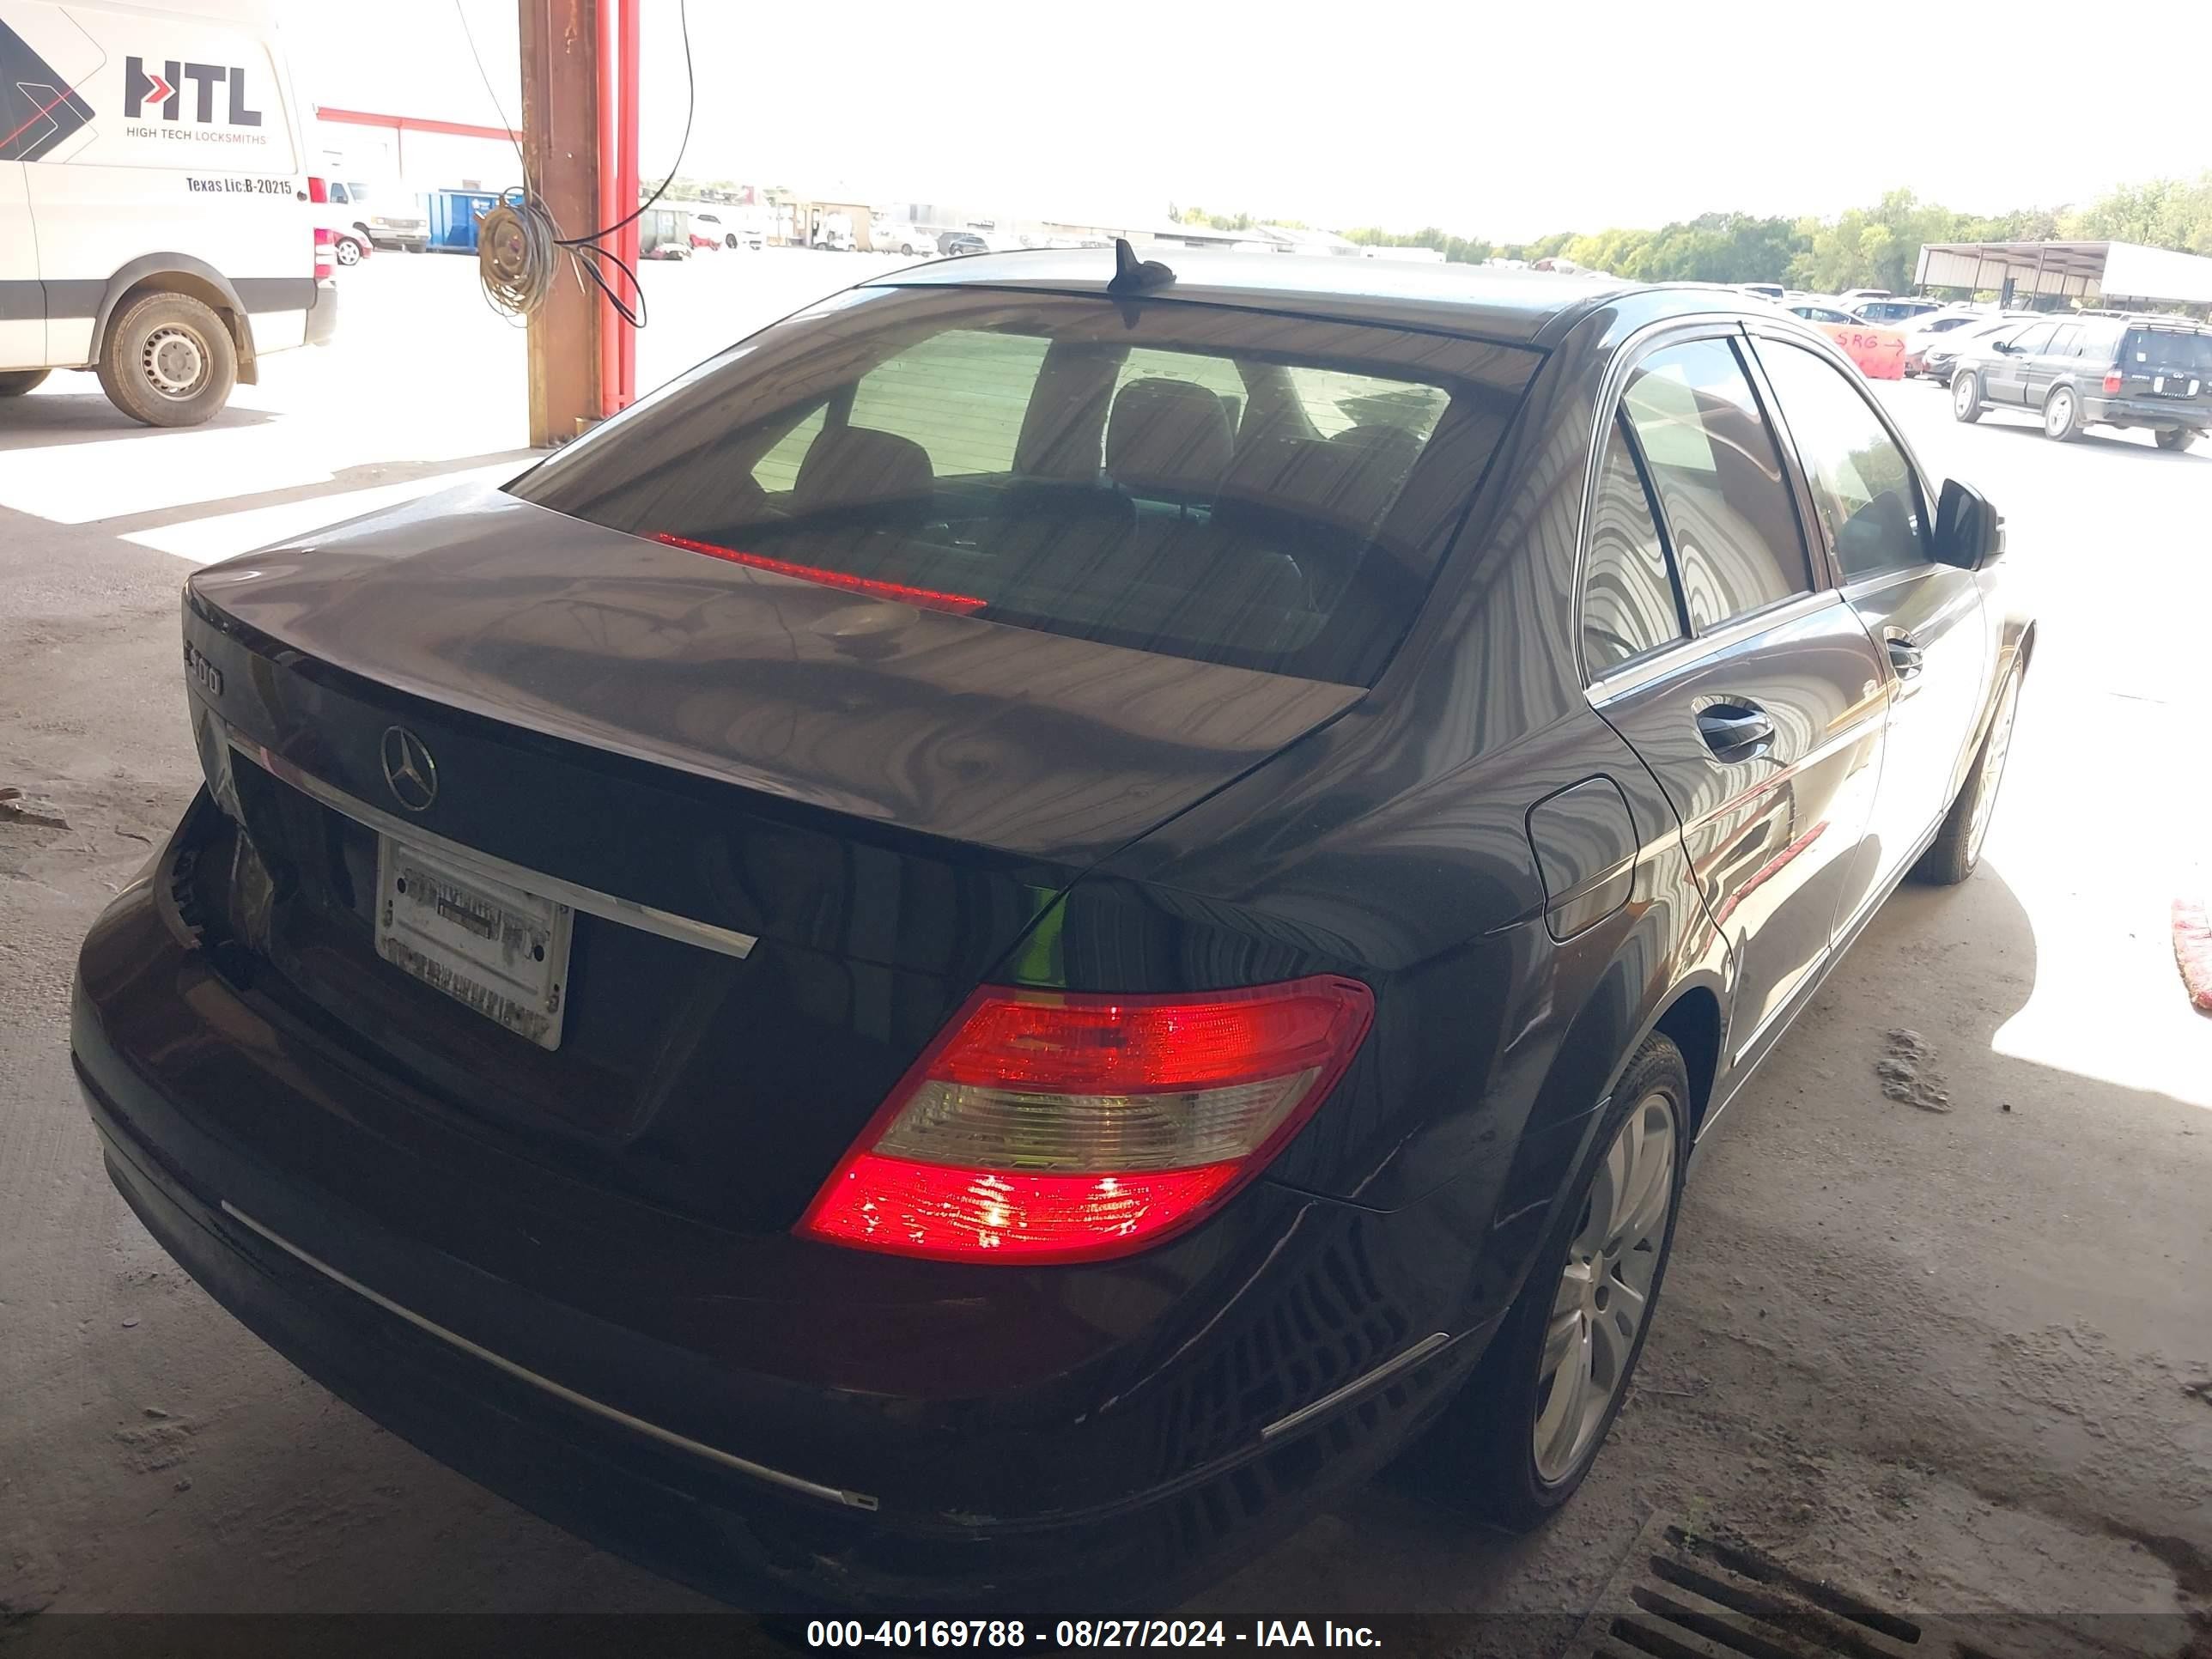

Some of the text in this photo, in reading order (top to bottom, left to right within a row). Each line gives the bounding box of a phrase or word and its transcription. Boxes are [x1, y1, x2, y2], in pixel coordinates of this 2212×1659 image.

[125, 56, 262, 126] HTL
[126, 126, 266, 145] HIGH TECH LOCKSMITHS
[186, 178, 222, 191] Texas
